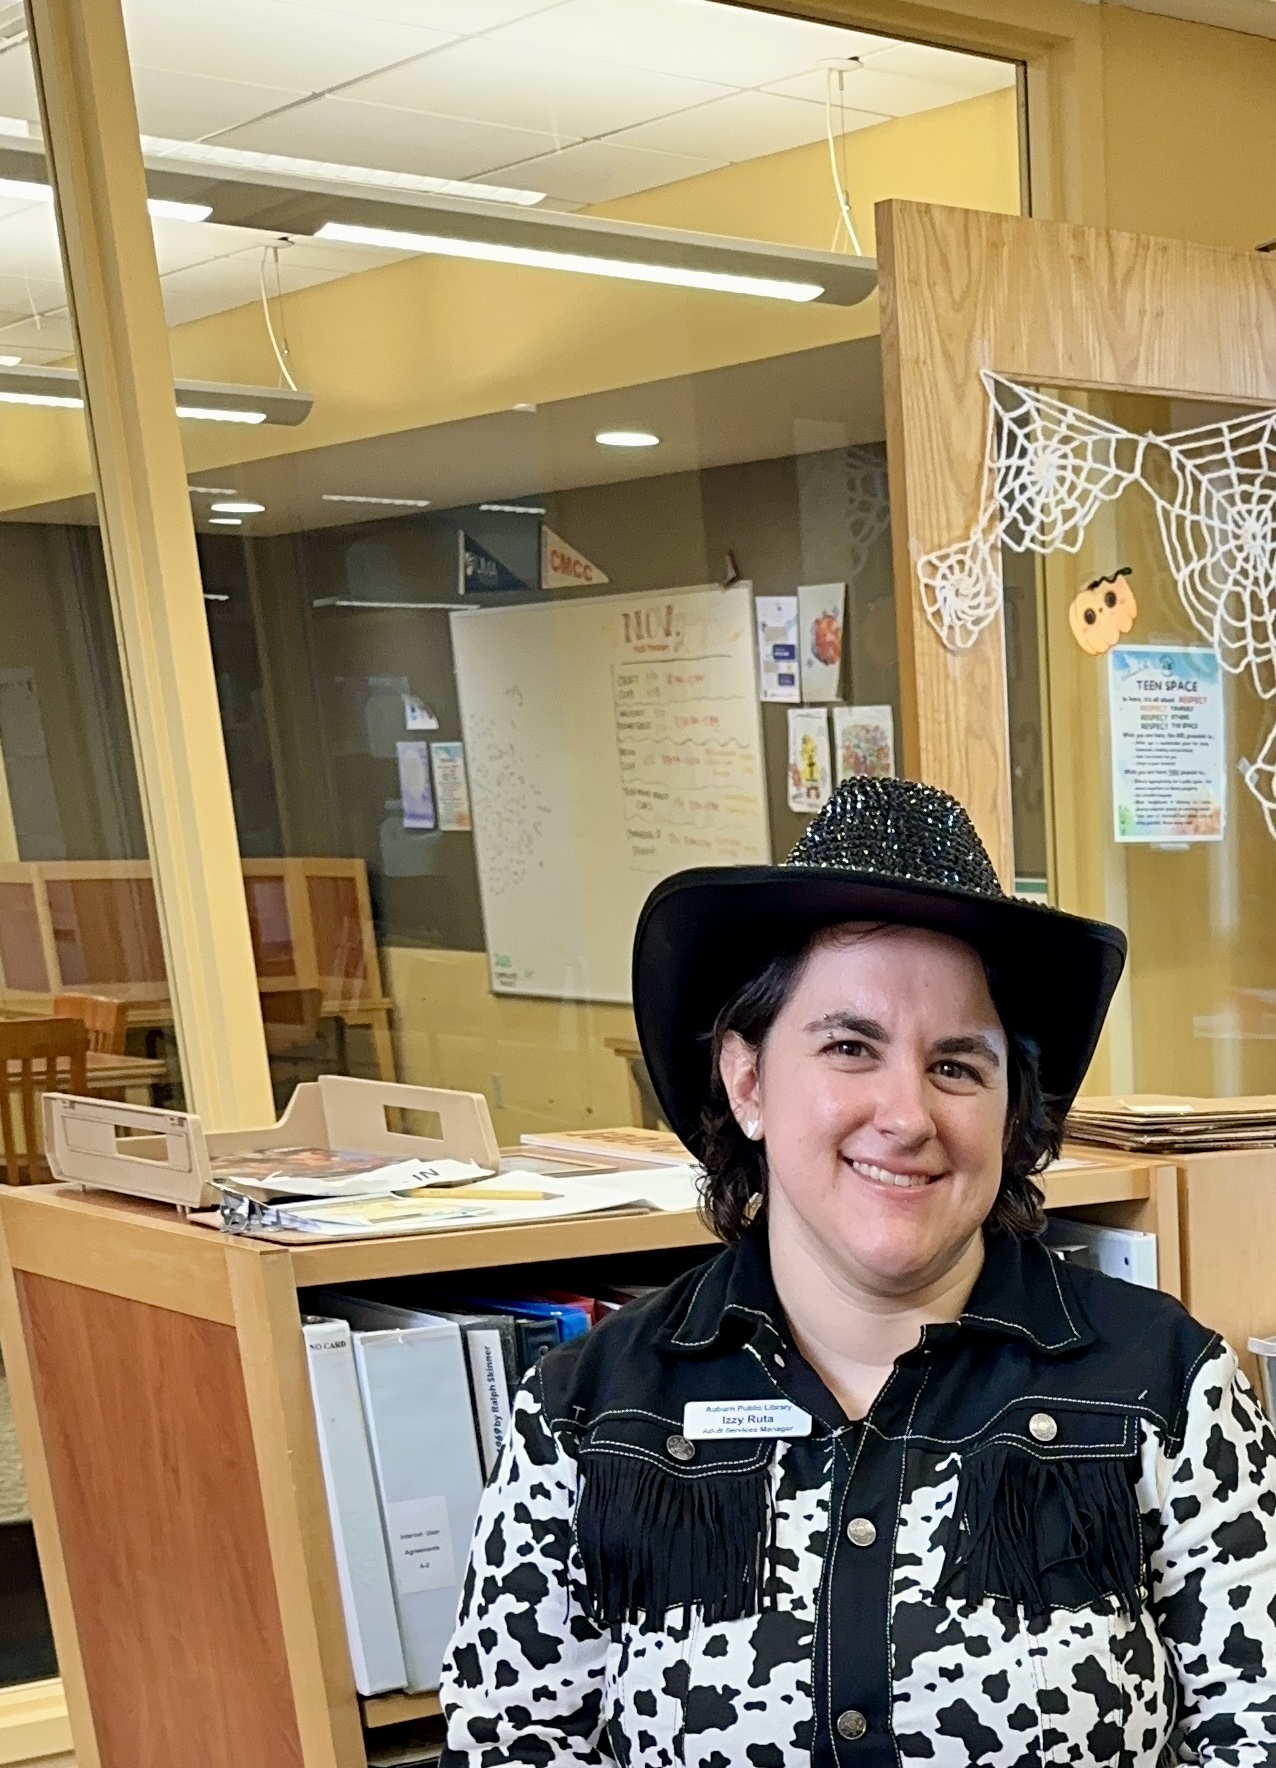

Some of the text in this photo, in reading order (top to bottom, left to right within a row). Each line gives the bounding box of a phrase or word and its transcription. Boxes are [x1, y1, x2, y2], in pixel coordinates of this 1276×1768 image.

[551, 549, 593, 582] CMCC
[1136, 680, 1198, 692] TEEN SPACE
[324, 1340, 347, 1350] CARD
[484, 1345, 496, 1383] Skinner
[488, 1384, 500, 1413] Ralph
[705, 1404, 792, 1413] Auburn Public Library
[494, 1414, 503, 1427] by
[722, 1414, 774, 1426] Izzy Ruta
[725, 1426, 757, 1434] Services
[760, 1425, 793, 1433] Manager
